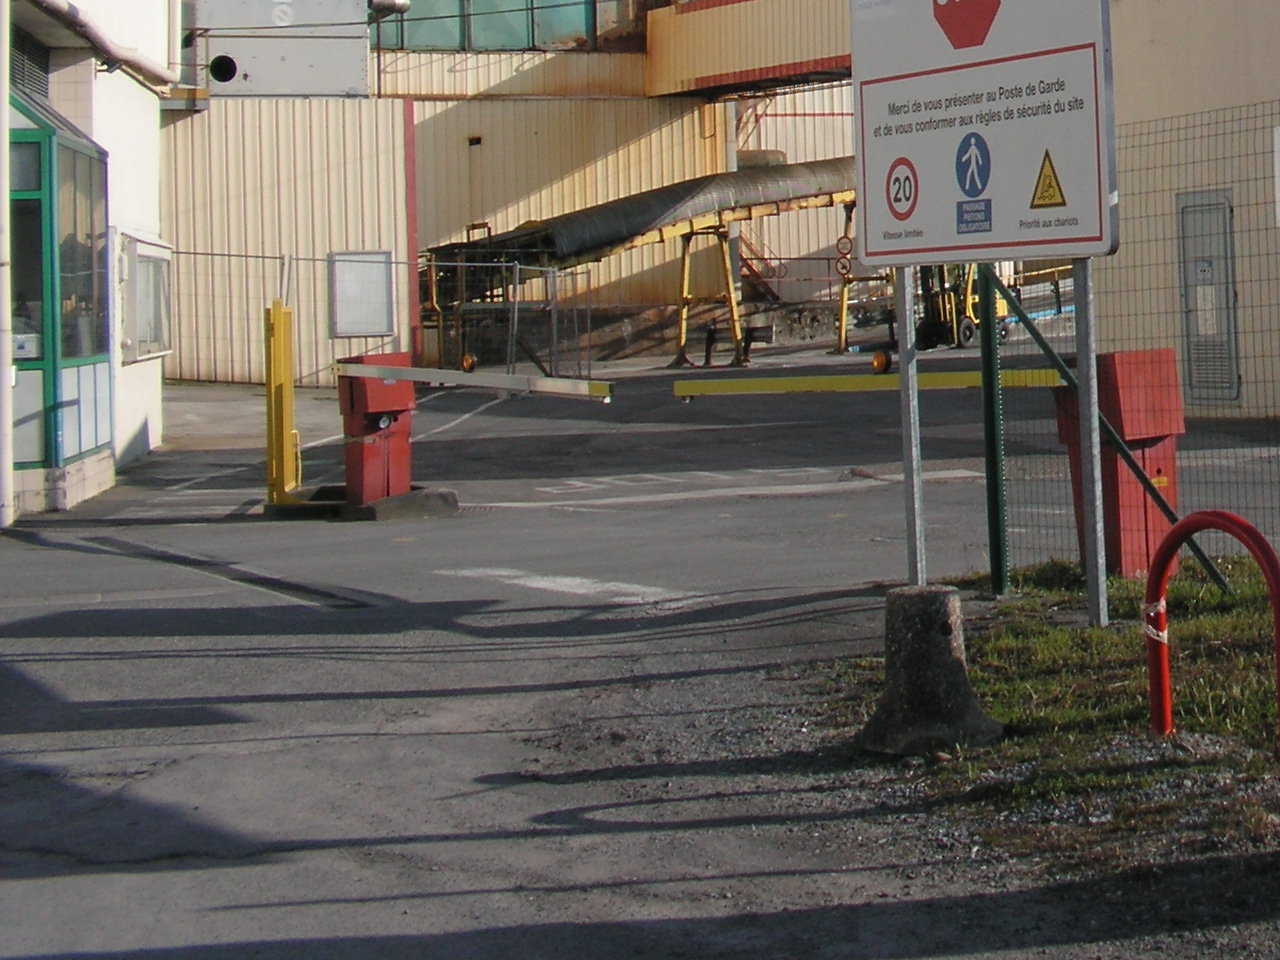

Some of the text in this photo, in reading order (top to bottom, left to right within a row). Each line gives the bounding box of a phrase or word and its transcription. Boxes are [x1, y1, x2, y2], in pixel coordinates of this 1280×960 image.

[888, 77, 1066, 116] Merci de vous présenter au Poste de Garde
[873, 96, 1085, 138] et de vous conformer aux règles de sécurité du site
[892, 175, 912, 204] 20
